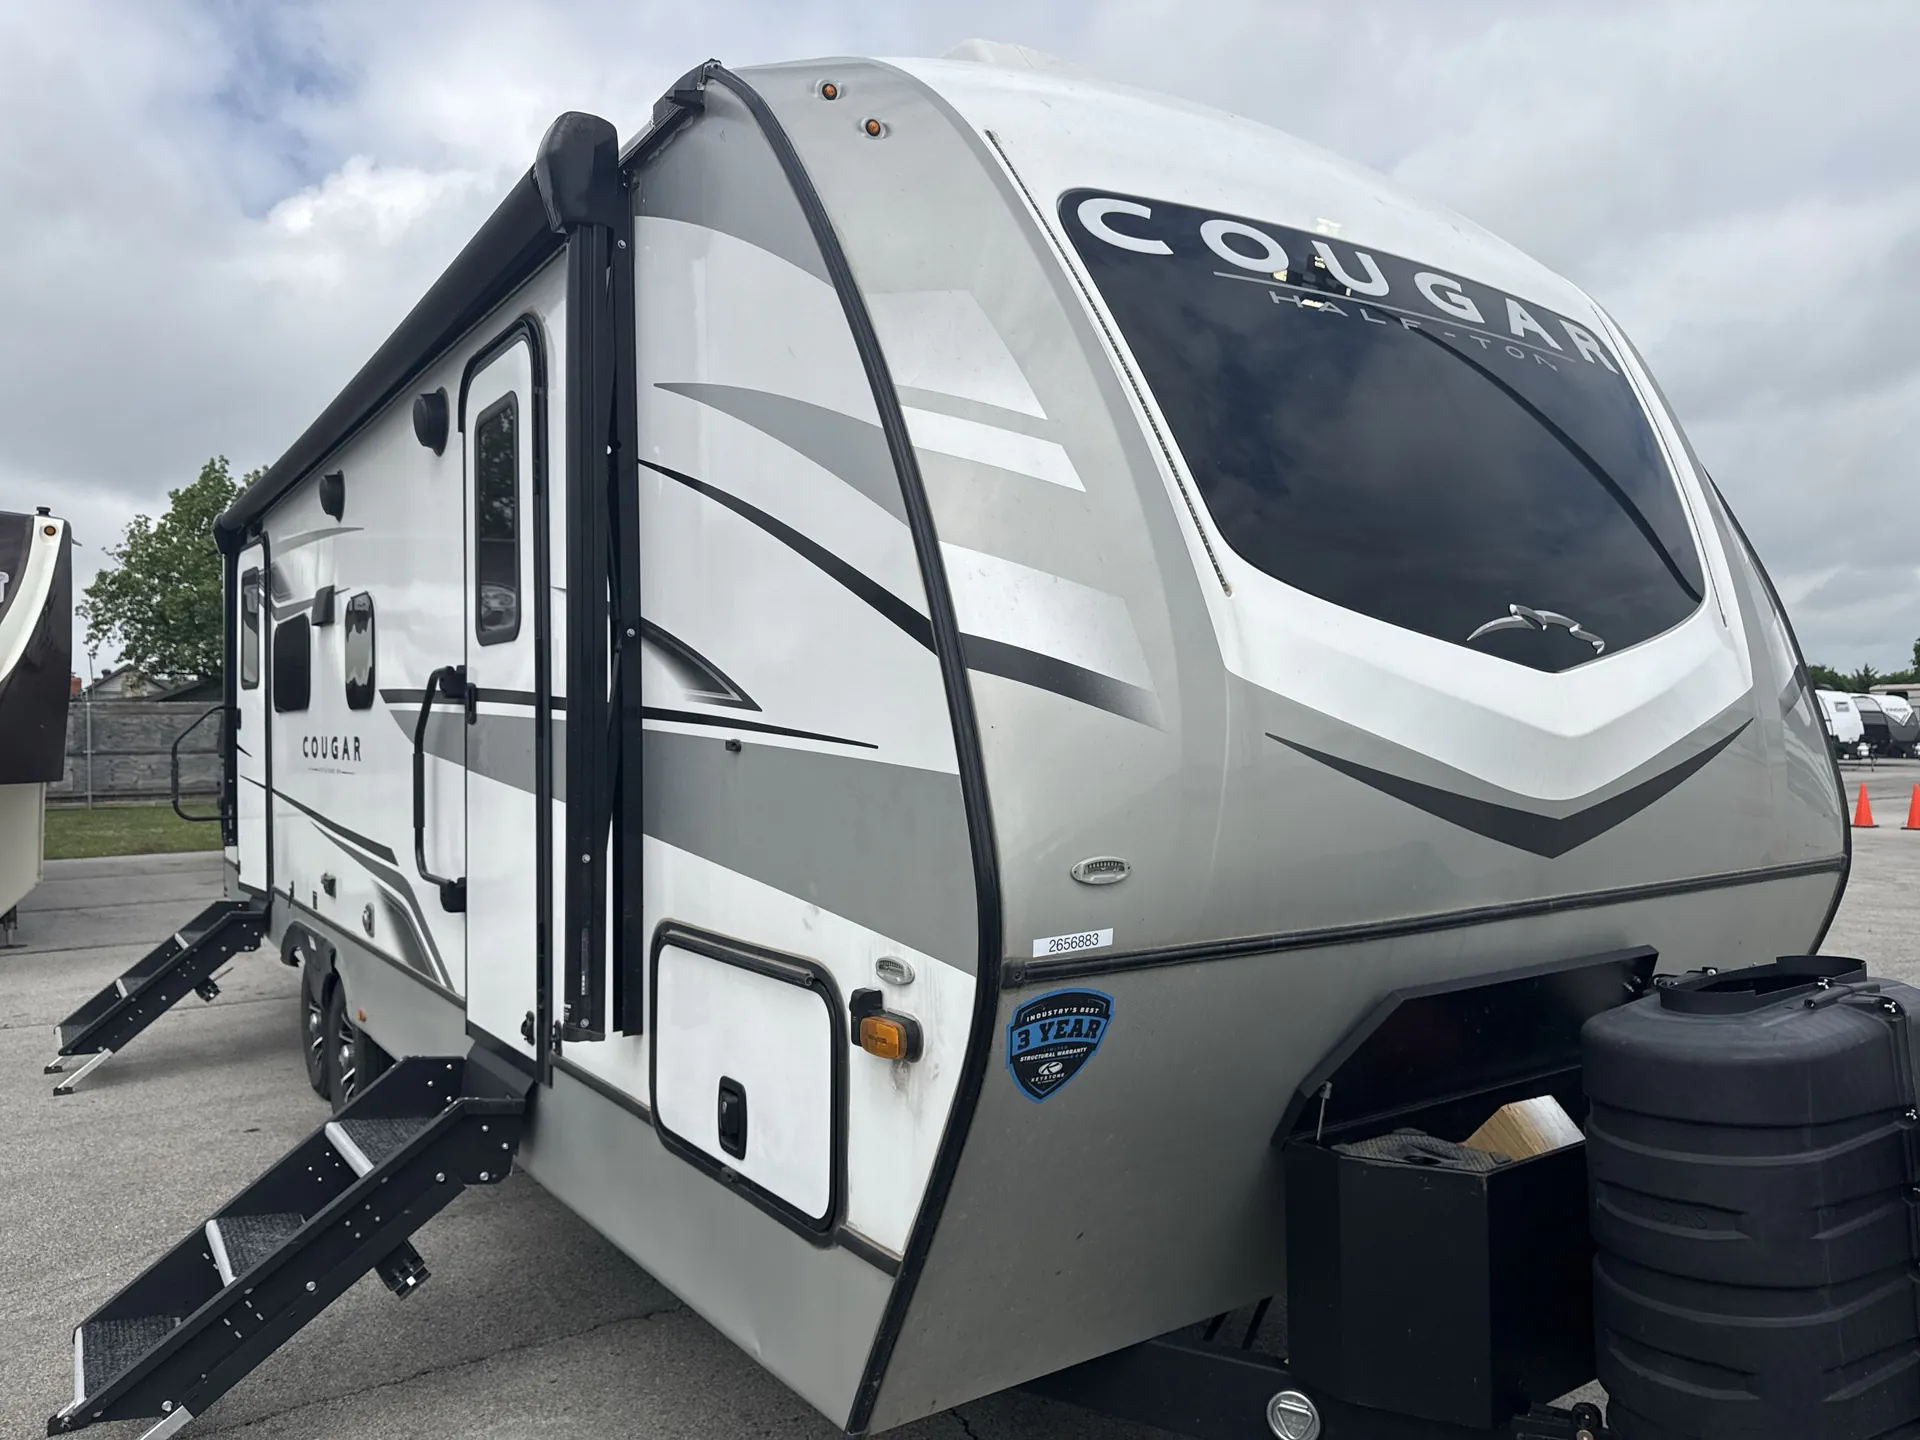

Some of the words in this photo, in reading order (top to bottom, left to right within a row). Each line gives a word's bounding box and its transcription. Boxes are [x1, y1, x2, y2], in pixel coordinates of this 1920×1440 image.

[1077, 197, 1619, 375] COUGAR
[302, 735, 362, 762] COUGAR
[1048, 932, 1100, 953] 2656883
[1026, 1006, 1078, 1023] INDUSTRY'S
[1079, 1006, 1100, 1014] BEST
[1017, 1028, 1031, 1051] 3
[1039, 1018, 1102, 1043] YEAR
[1020, 1052, 1056, 1062] STRUCTURAL
[1057, 1046, 1088, 1056] WARRANTY
[1030, 1072, 1066, 1083] KEYSTONE
